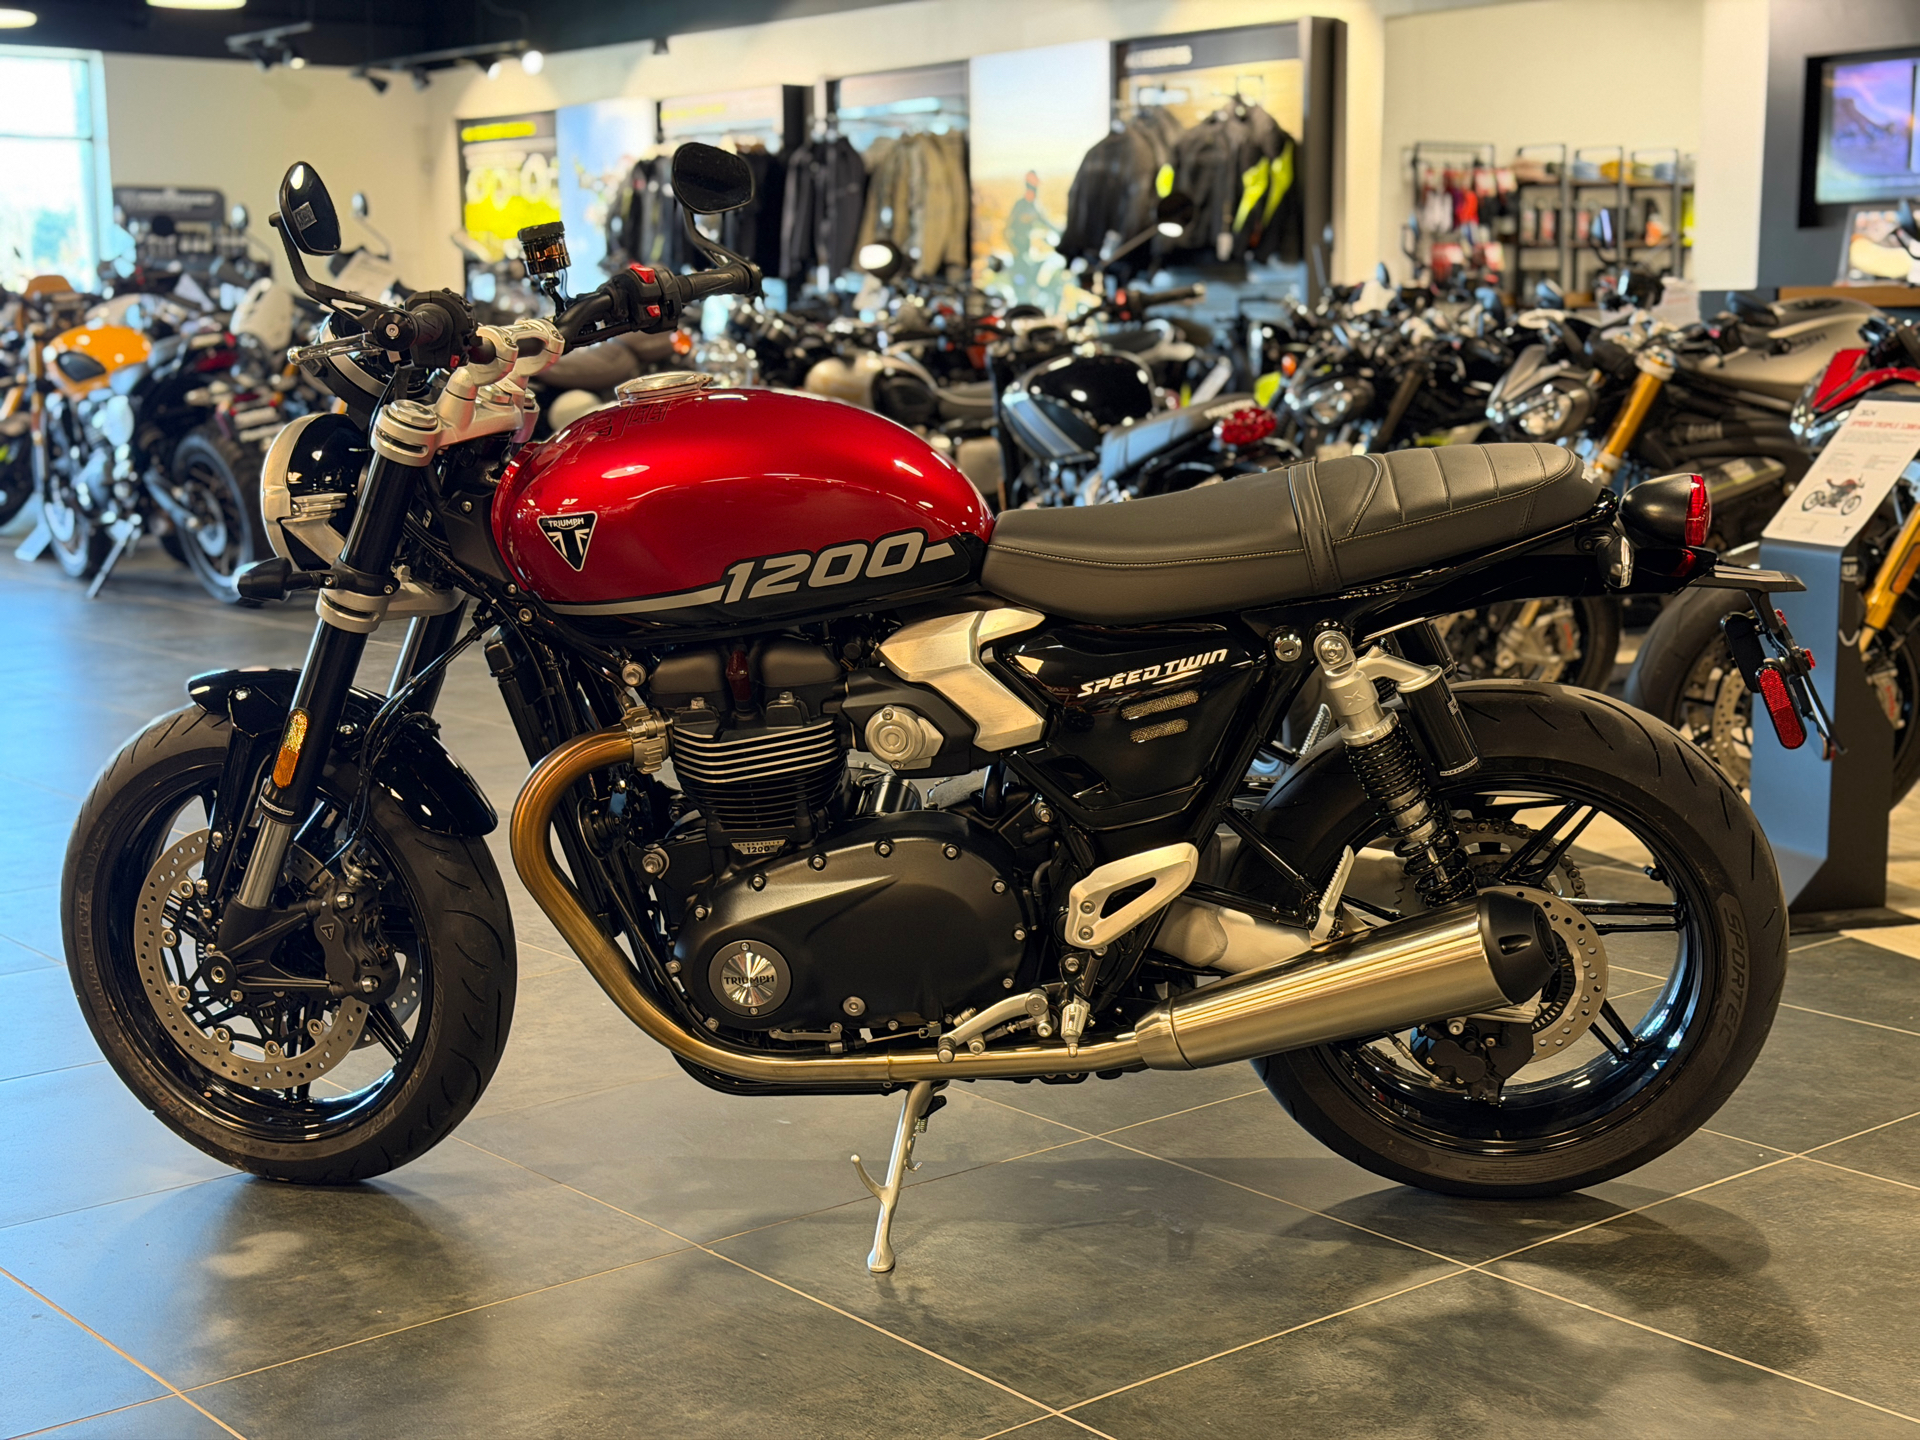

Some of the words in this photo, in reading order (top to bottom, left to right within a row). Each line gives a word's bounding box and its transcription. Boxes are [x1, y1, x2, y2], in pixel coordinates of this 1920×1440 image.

[548, 517, 585, 529] TRIUMPH
[724, 531, 925, 604] 1200
[1077, 664, 1161, 698] SPEED
[1164, 649, 1229, 675] TWIN
[723, 974, 775, 987] TRIUMPH
[1719, 907, 1746, 1048] SPORTEC
